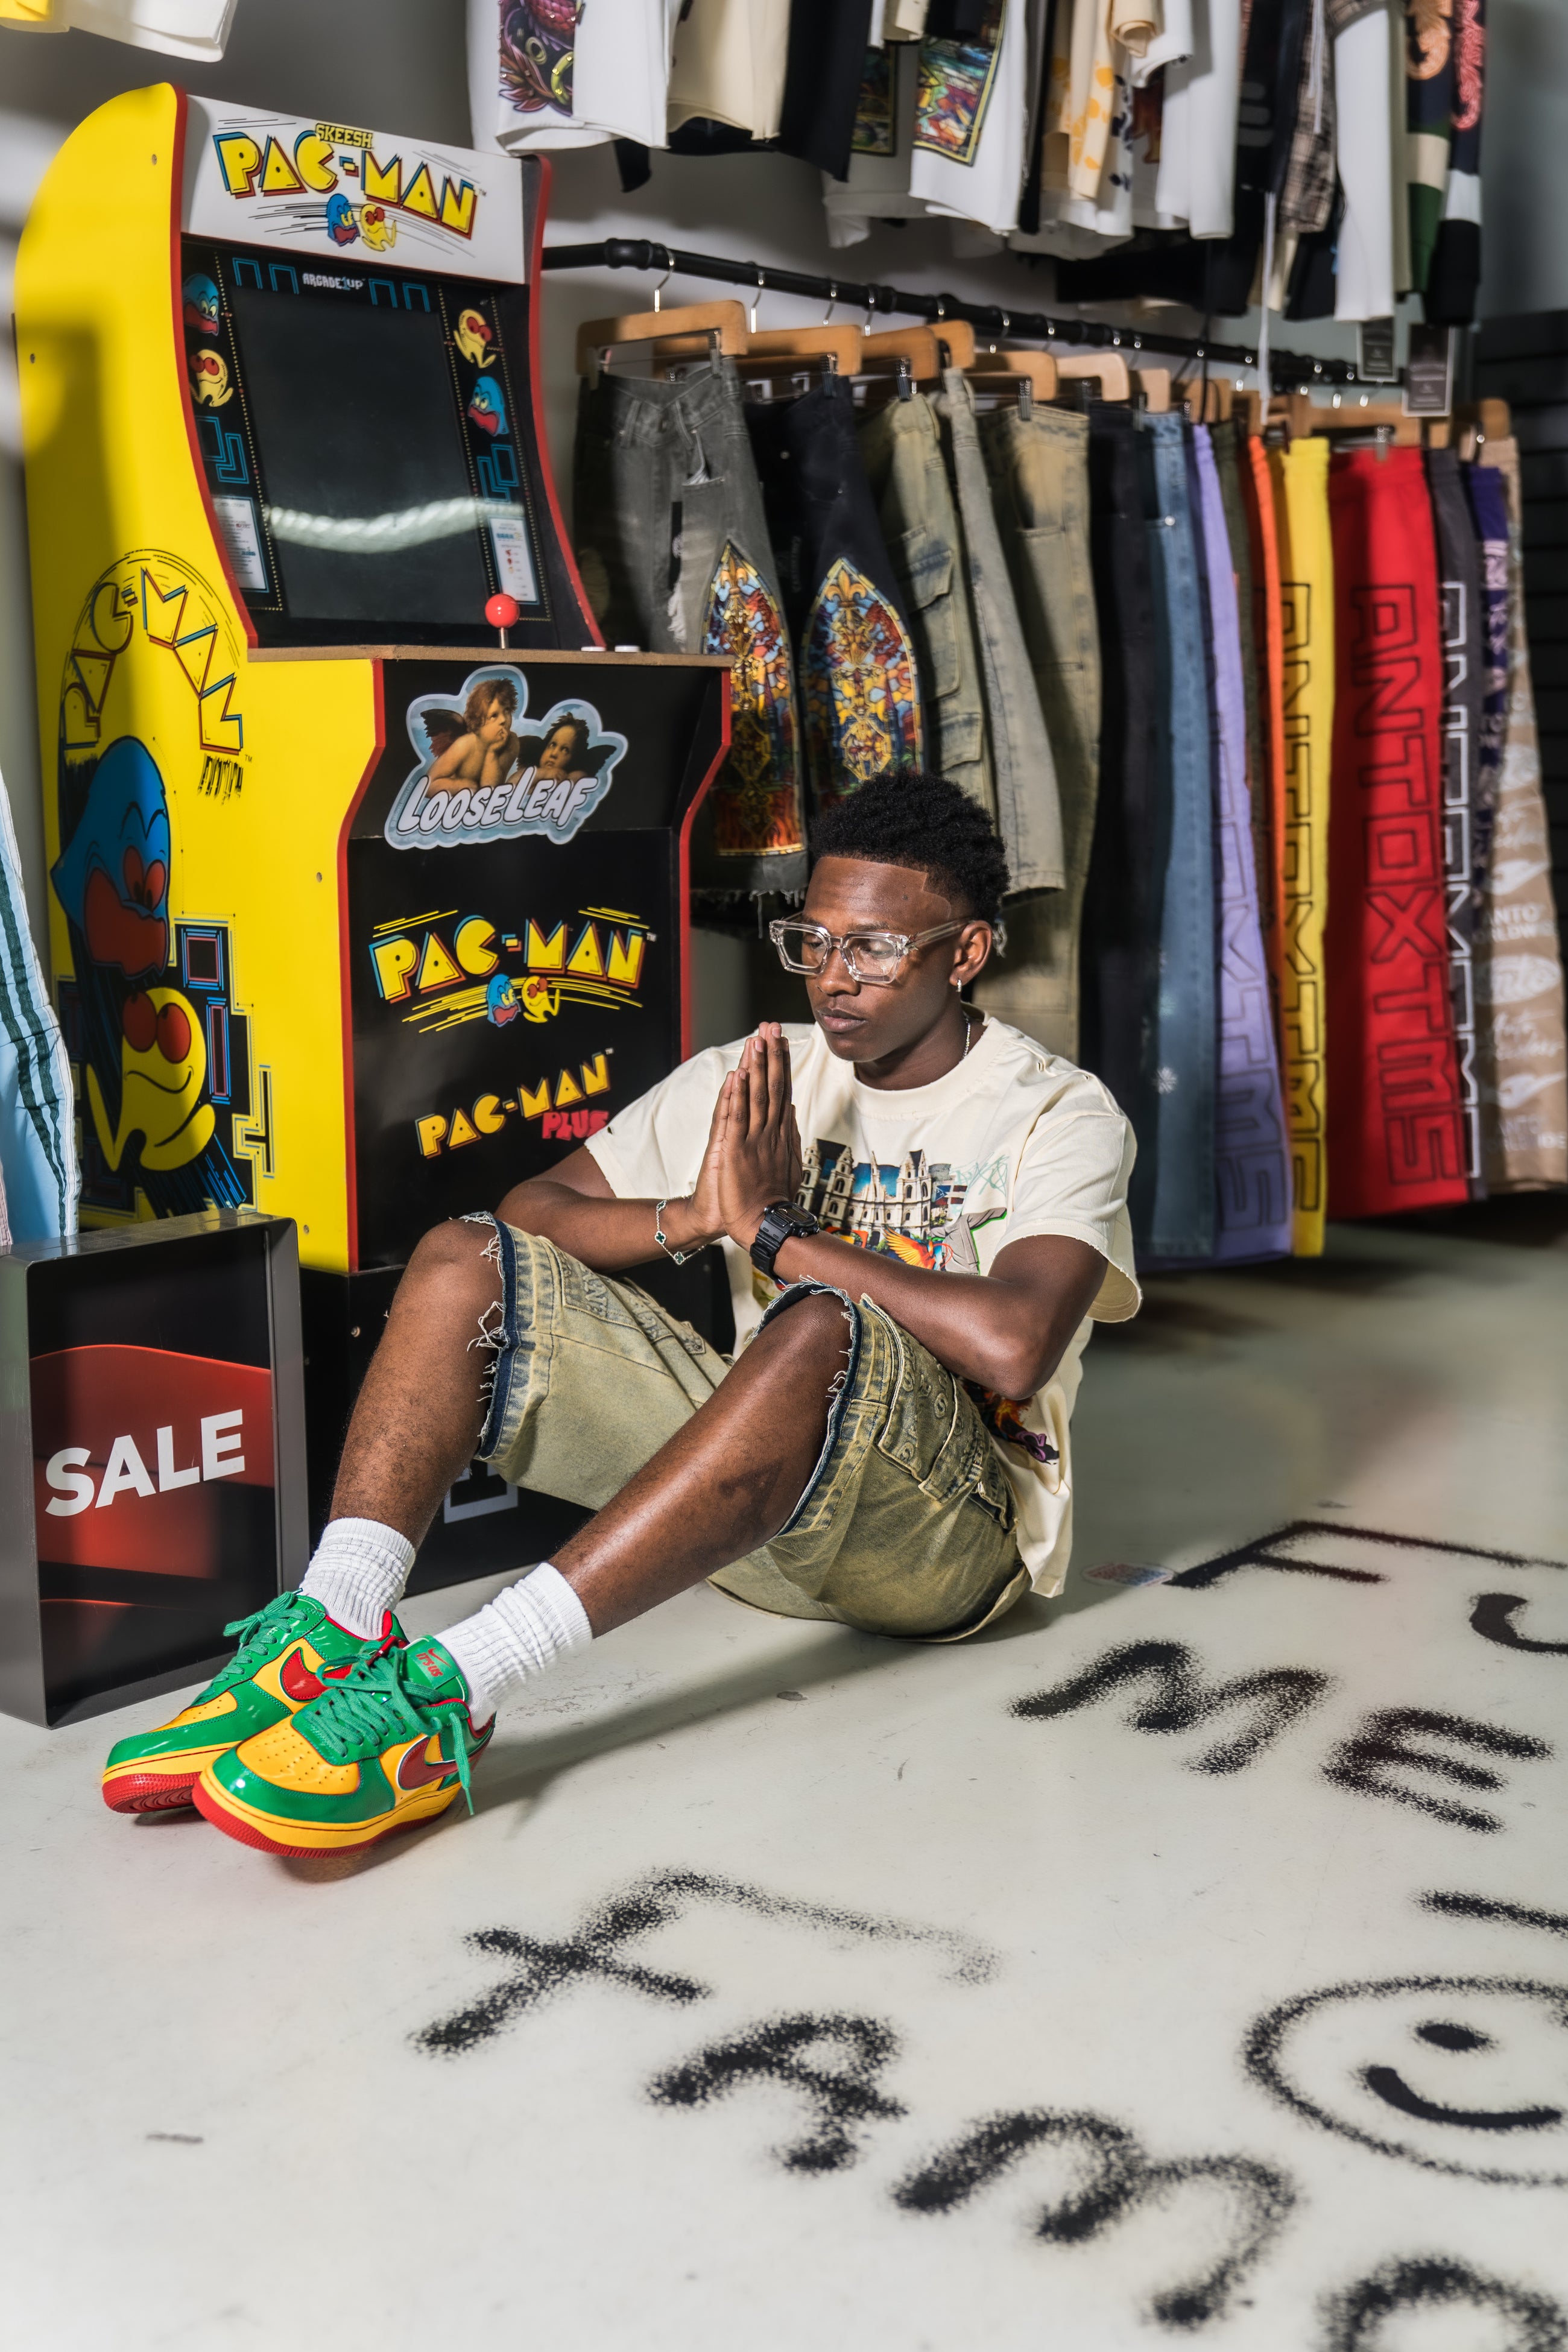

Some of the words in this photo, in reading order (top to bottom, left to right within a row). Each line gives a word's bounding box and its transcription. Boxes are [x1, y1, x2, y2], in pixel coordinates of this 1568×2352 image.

[213, 130, 478, 241] PAC-MAN
[315, 122, 374, 150] SKEESH
[62, 566, 243, 756] PAC-MAN
[1350, 584, 1464, 1184] ANTOXTMS
[369, 915, 645, 1004] PAC-MAN
[415, 1052, 610, 1159] PAC-MAN
[542, 1109, 609, 1140] PLUS
[45, 1409, 245, 1517] SALE
[428, 1665, 444, 1677] US
